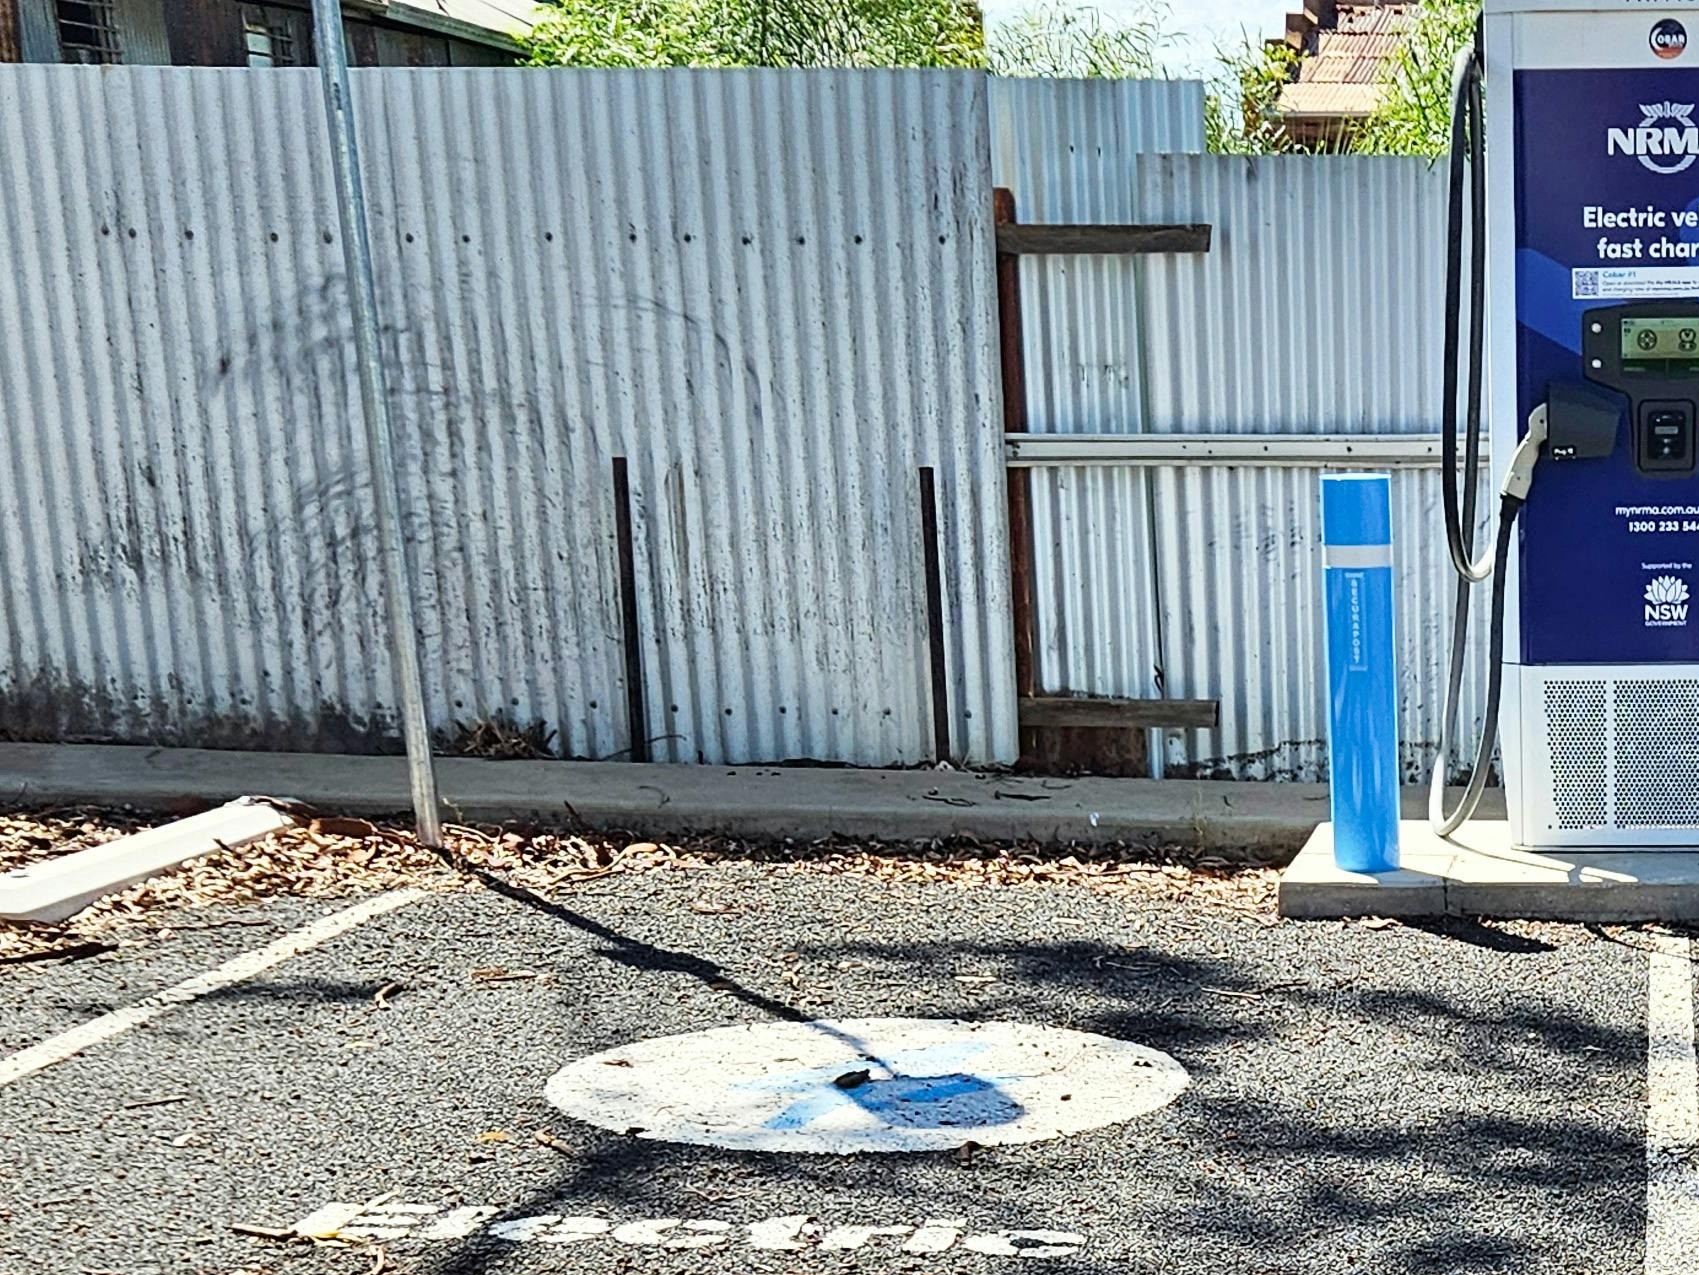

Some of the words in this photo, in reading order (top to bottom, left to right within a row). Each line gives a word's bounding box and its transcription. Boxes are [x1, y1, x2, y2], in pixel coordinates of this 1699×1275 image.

[1651, 27, 1685, 51] COBAR
[1583, 206, 1665, 228] Electric
[1597, 237, 1642, 259] fast
[1629, 521, 1655, 532] 1300
[1659, 521, 1679, 531] 233
[1645, 604, 1688, 620] NSW
[293, 1198, 1087, 1258] Electric
